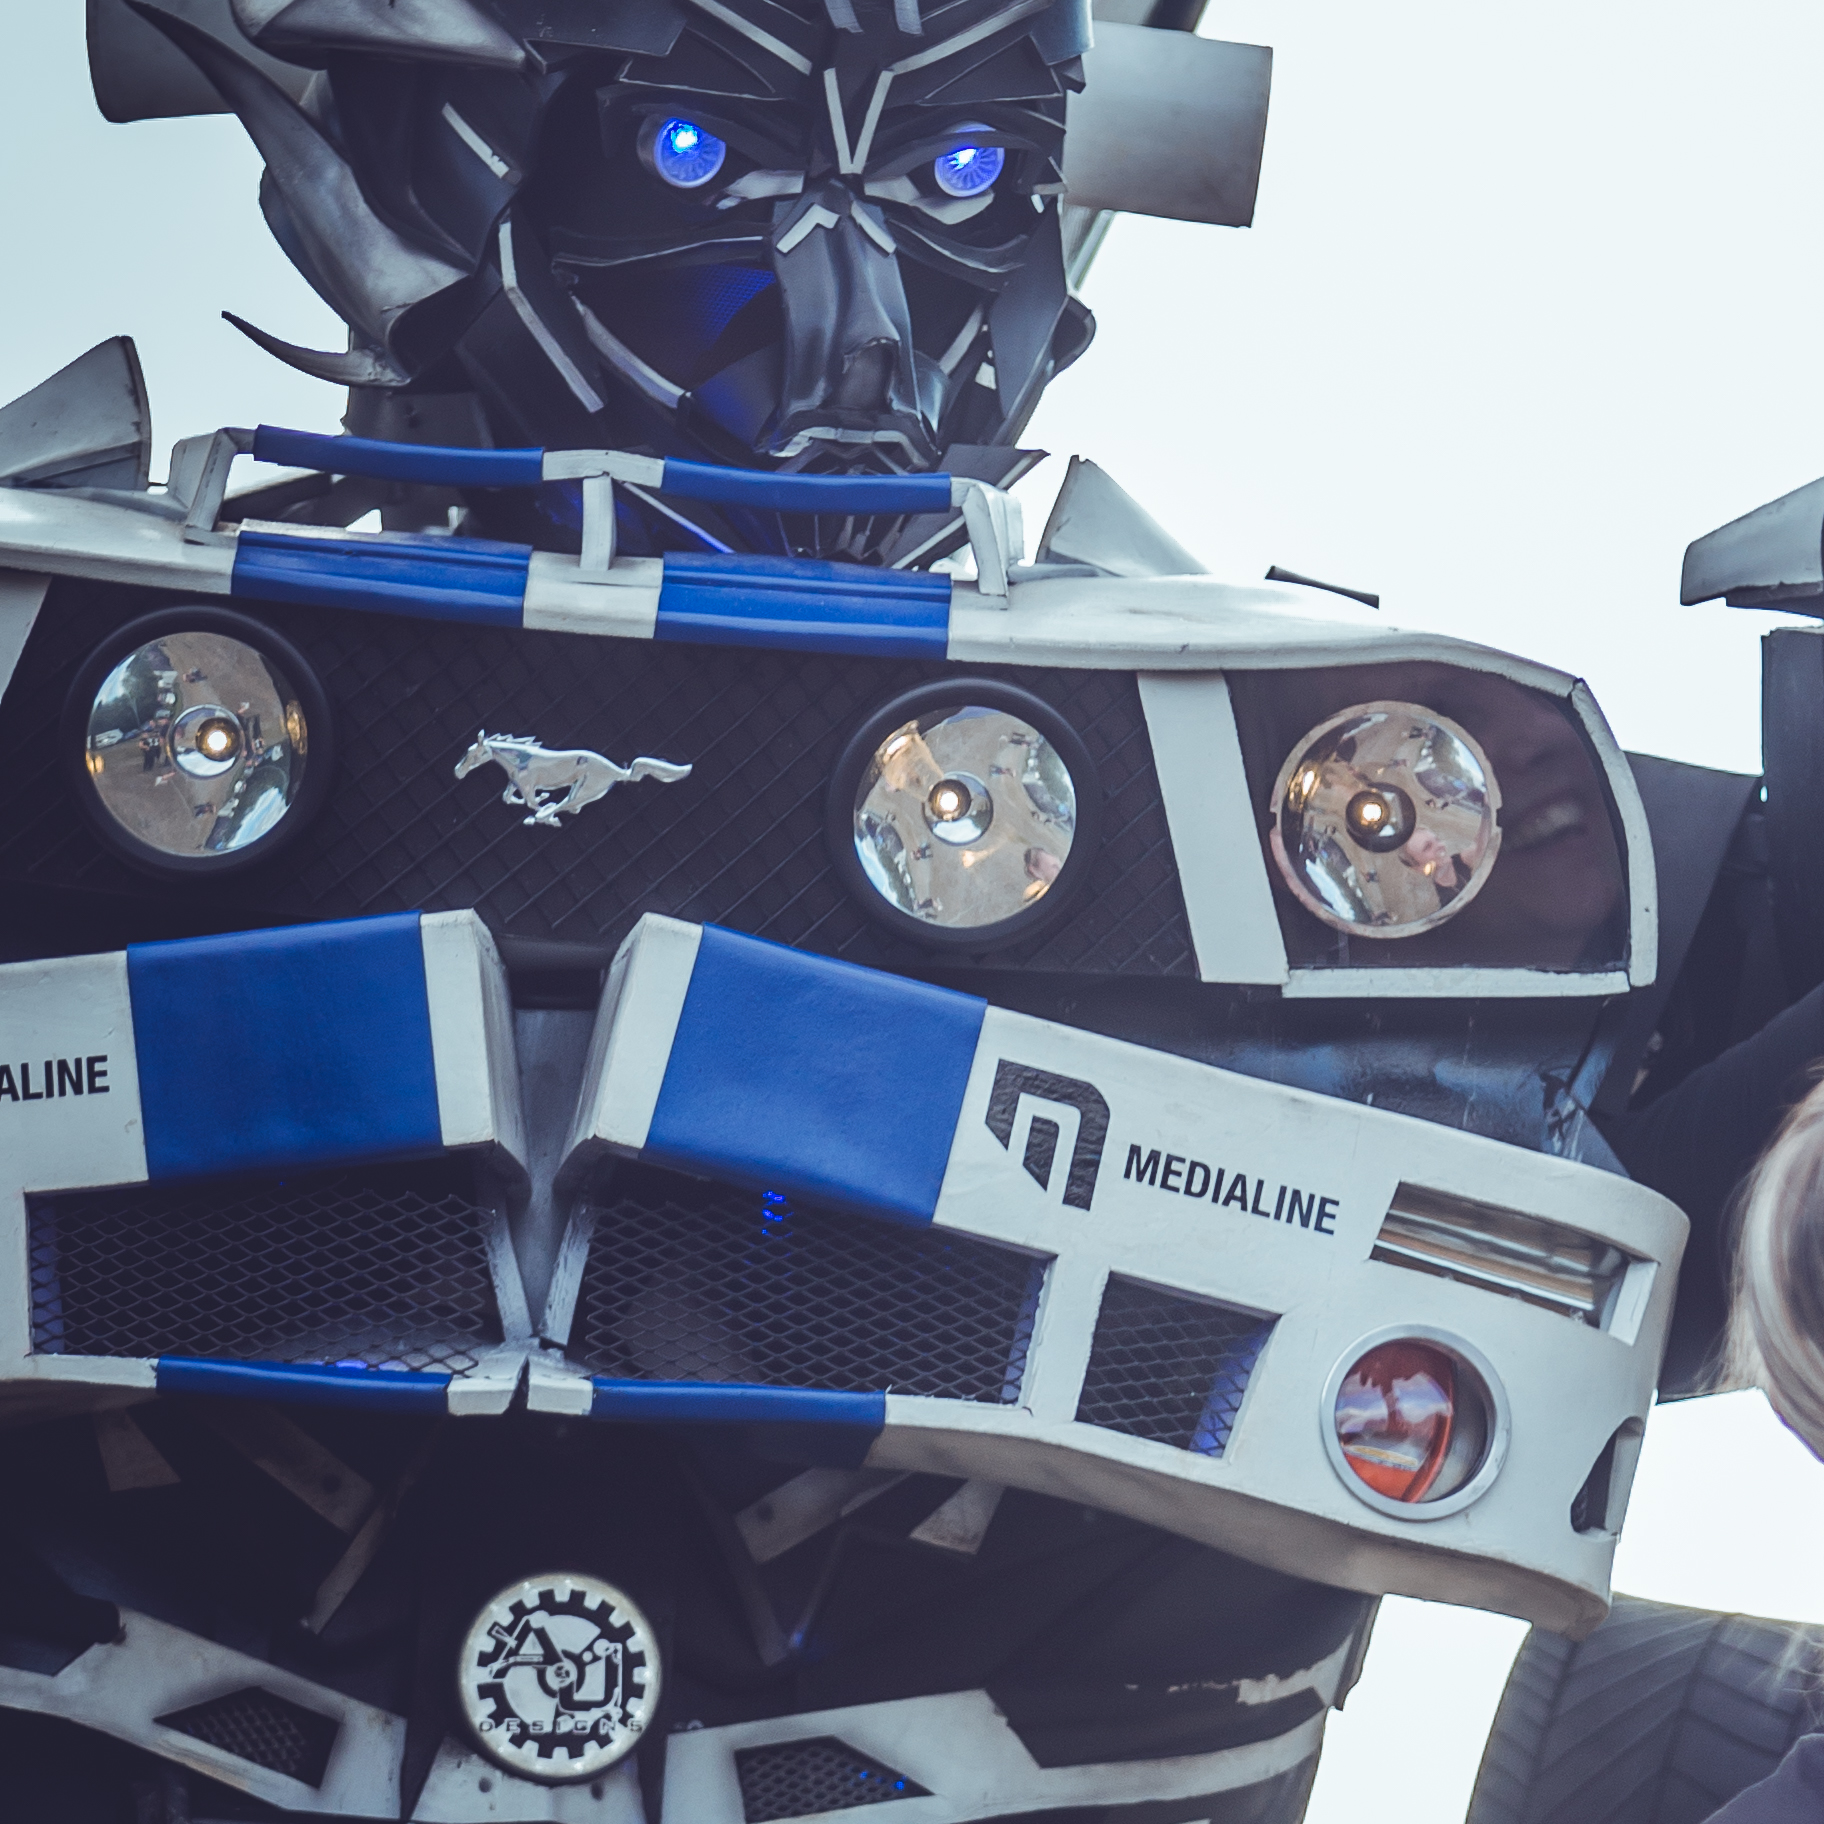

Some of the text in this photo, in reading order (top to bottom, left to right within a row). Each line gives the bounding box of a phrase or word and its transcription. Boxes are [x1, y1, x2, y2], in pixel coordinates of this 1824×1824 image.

[0, 1054, 110, 1102] ALINE
[1123, 1143, 1340, 1236] MEDIALINE
[479, 1719, 643, 1734] DESIGNS
